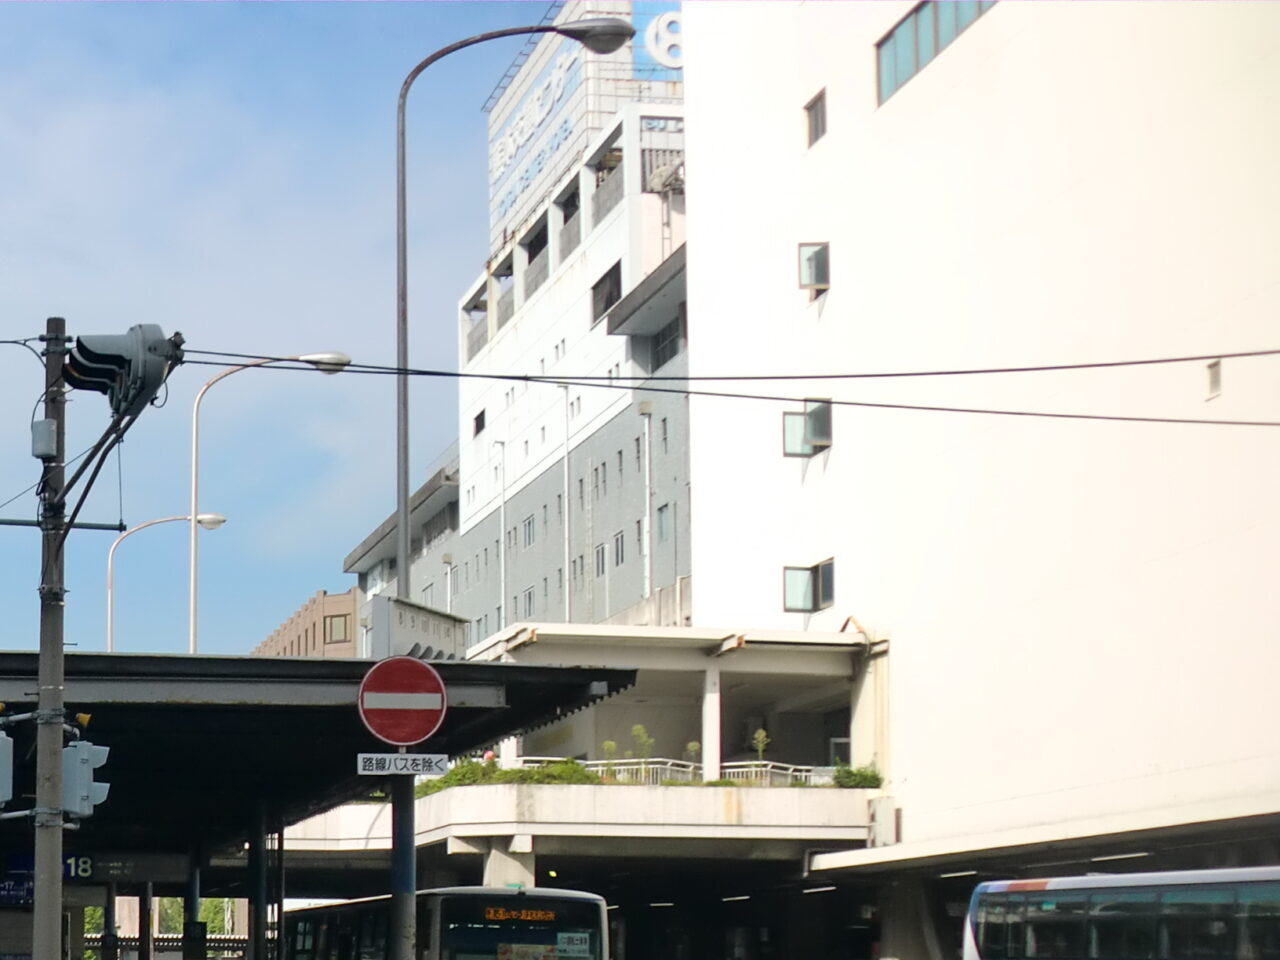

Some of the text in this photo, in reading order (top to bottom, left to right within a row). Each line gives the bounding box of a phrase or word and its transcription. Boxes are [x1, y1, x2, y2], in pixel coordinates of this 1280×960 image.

[361, 756, 445, 773] 路線バスを除く
[66, 857, 93, 877] 18
